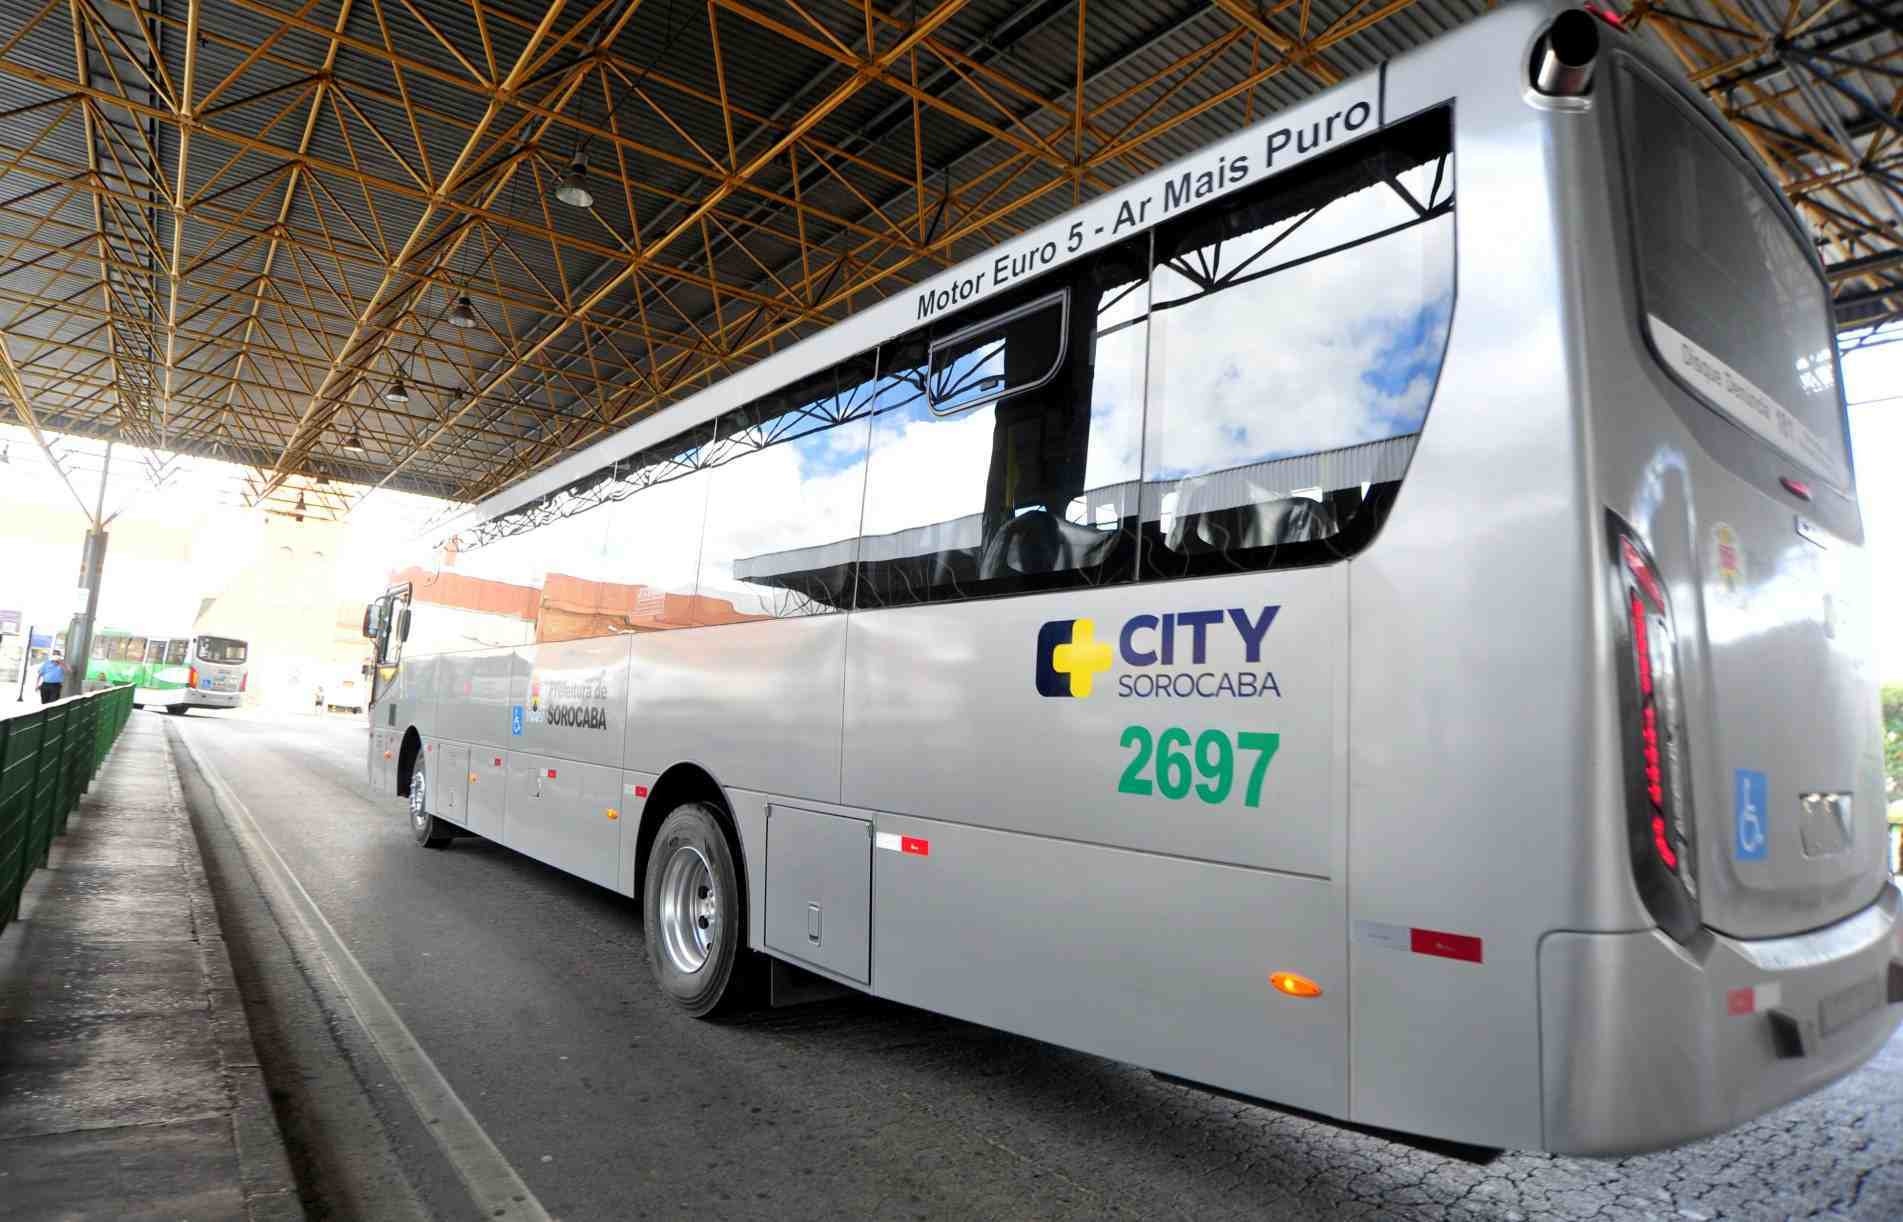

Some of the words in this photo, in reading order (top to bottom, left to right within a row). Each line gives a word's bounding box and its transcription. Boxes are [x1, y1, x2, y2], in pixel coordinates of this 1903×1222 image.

[917, 273, 985, 320] Motor
[993, 242, 1057, 286] Euro
[1067, 222, 1084, 253] 5
[1112, 198, 1152, 235] Ar
[1163, 155, 1249, 213] Mais
[1265, 100, 1371, 168] Puro
[1119, 605, 1282, 667] CITY
[1118, 672, 1282, 698] SOROCABA
[547, 704, 607, 730] SOROCABA
[1118, 725, 1281, 808] 2697
